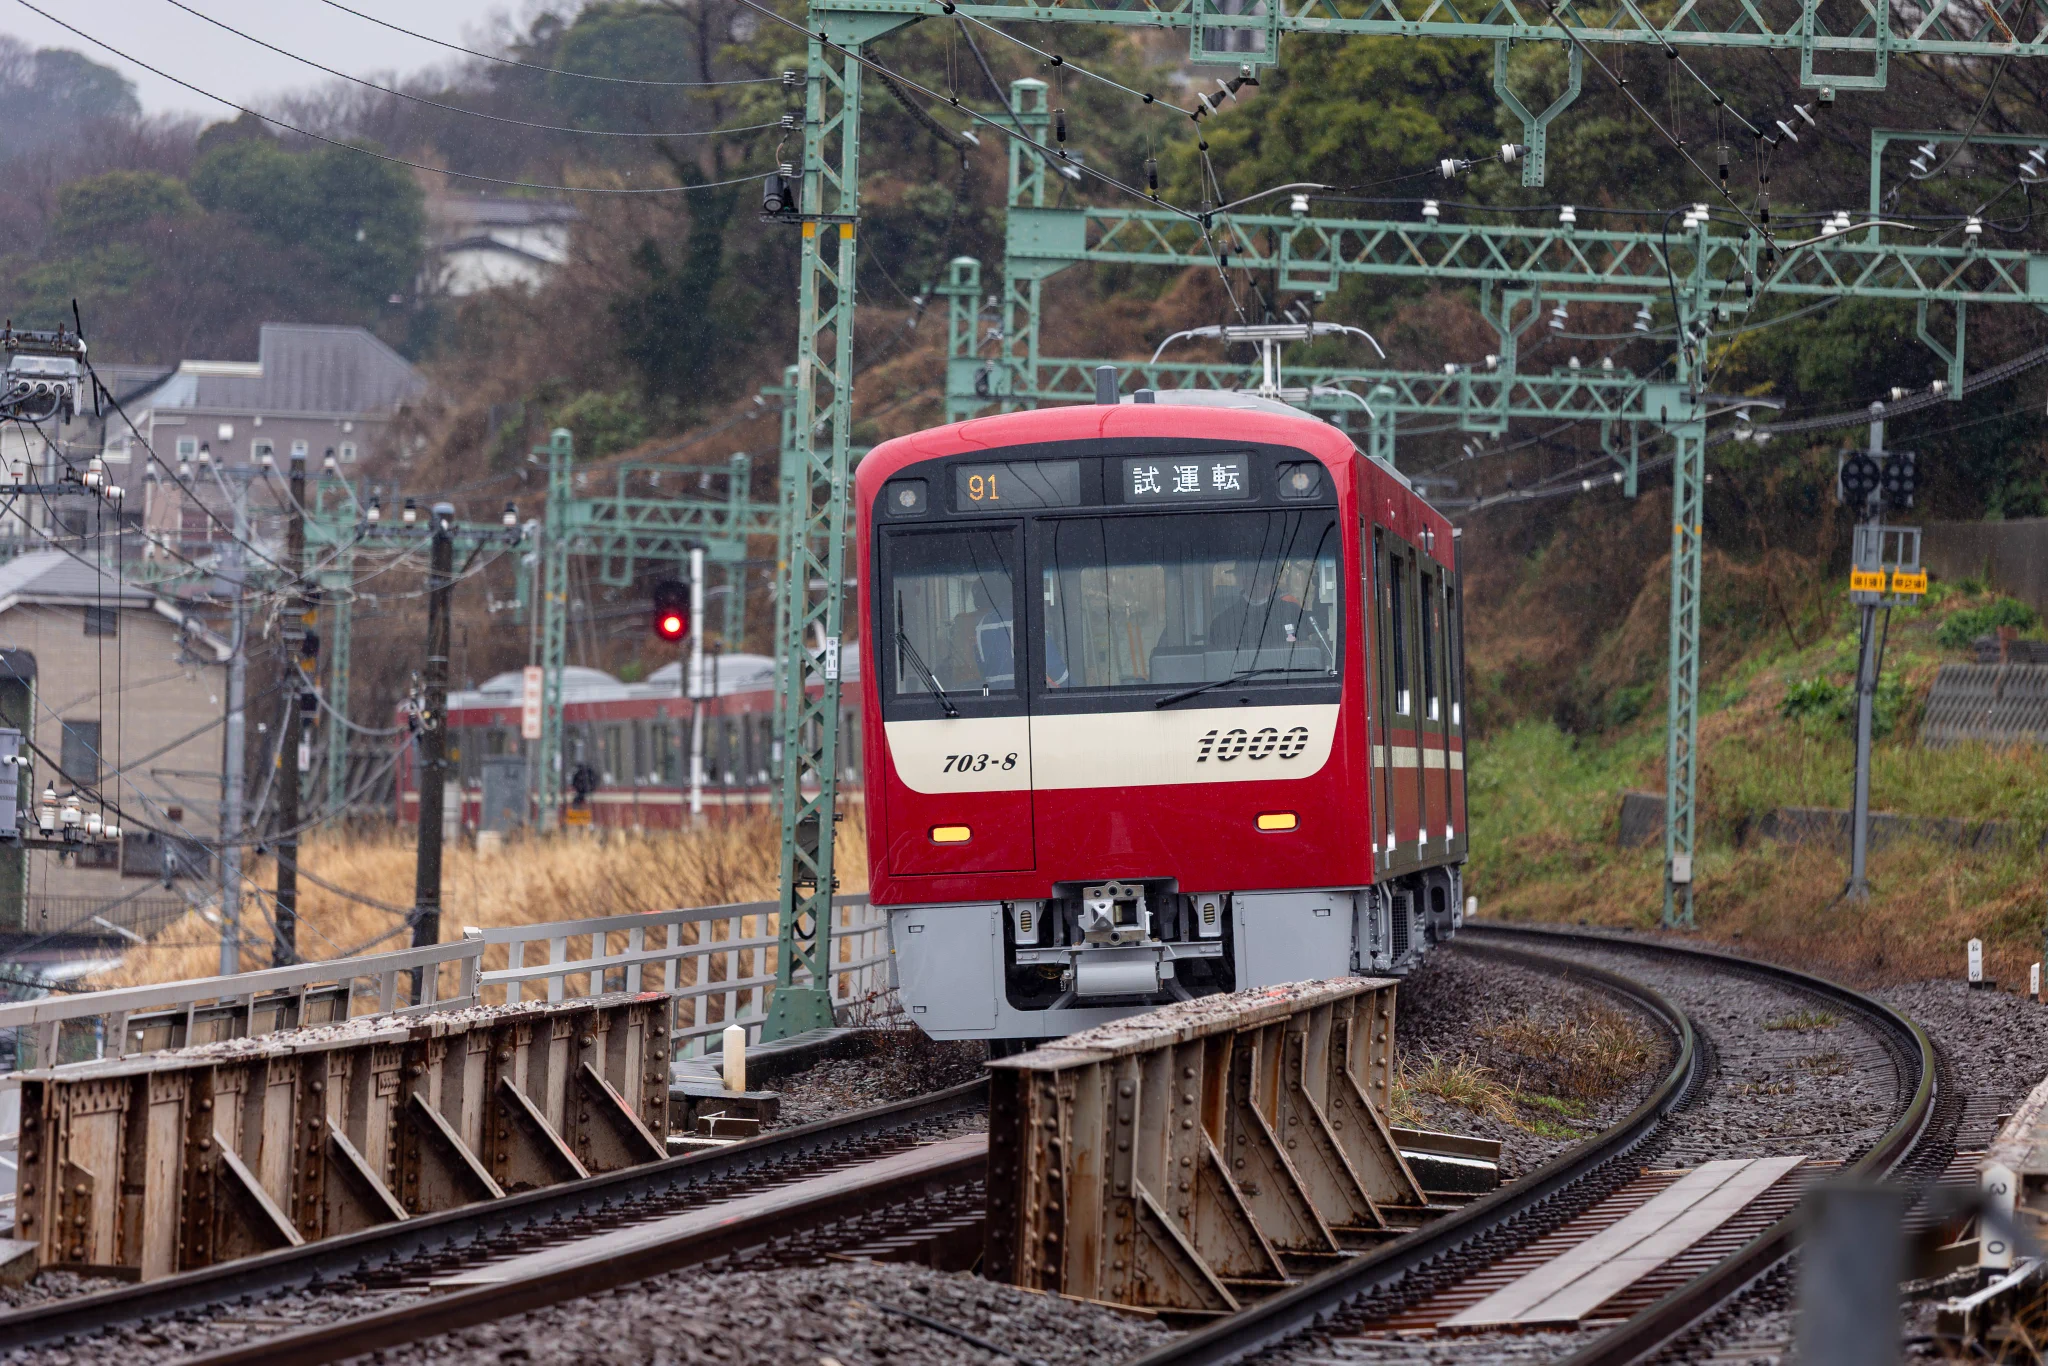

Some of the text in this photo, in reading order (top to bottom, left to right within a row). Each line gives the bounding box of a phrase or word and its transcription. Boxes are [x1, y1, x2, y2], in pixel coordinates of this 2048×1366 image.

[968, 474, 1000, 501] 91
[1132, 464, 1241, 495] 試運転
[1197, 726, 1309, 763] 1000
[942, 752, 1018, 774] 703-8
